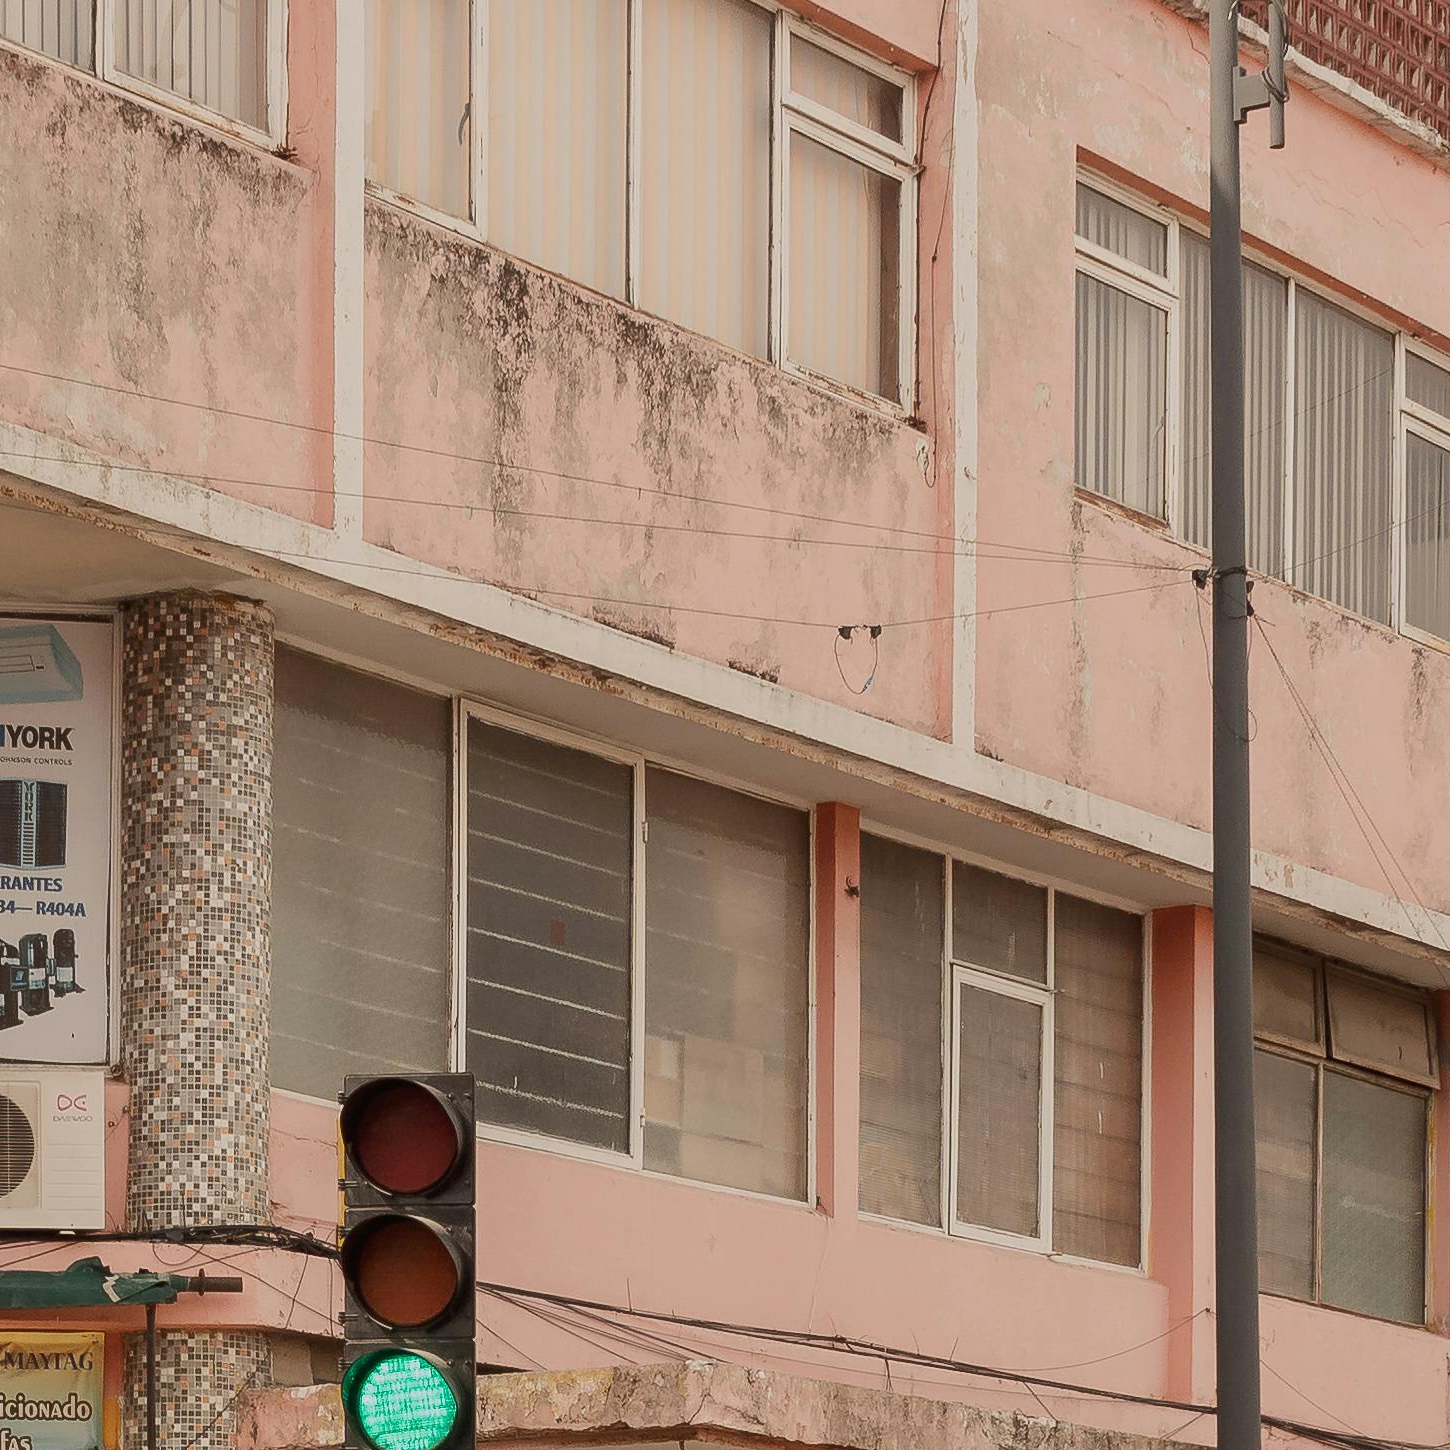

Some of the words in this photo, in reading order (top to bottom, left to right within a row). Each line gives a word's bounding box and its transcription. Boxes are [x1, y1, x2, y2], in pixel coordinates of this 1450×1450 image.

[4, 724, 75, 751] YORK
[33, 757, 73, 767] CONTROLS
[36, 901, 86, 918] R404A
[4, 1351, 94, 1372] MAYTAG
